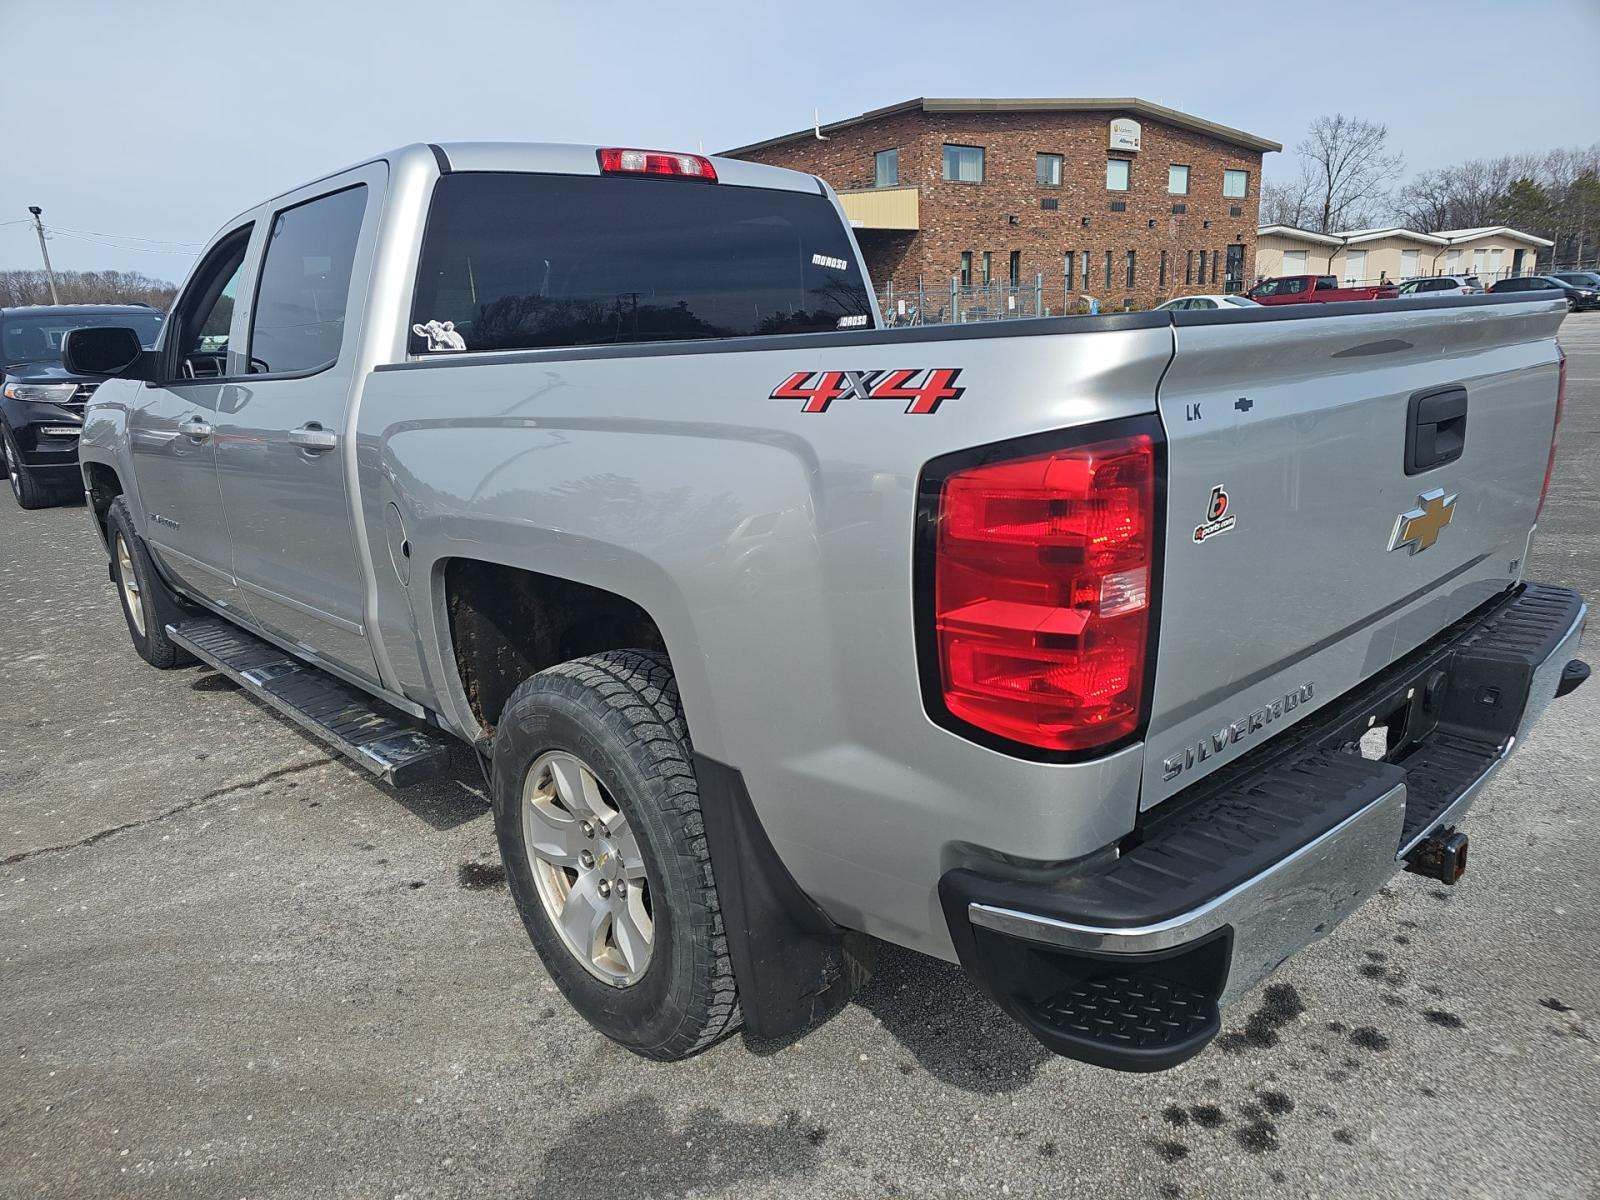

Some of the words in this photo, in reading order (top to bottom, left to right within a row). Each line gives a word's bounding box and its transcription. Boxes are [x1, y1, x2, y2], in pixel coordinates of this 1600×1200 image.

[812, 254, 847, 270] MOROSO
[1186, 403, 1201, 421] LK
[1162, 681, 1315, 782] SILVERADO
